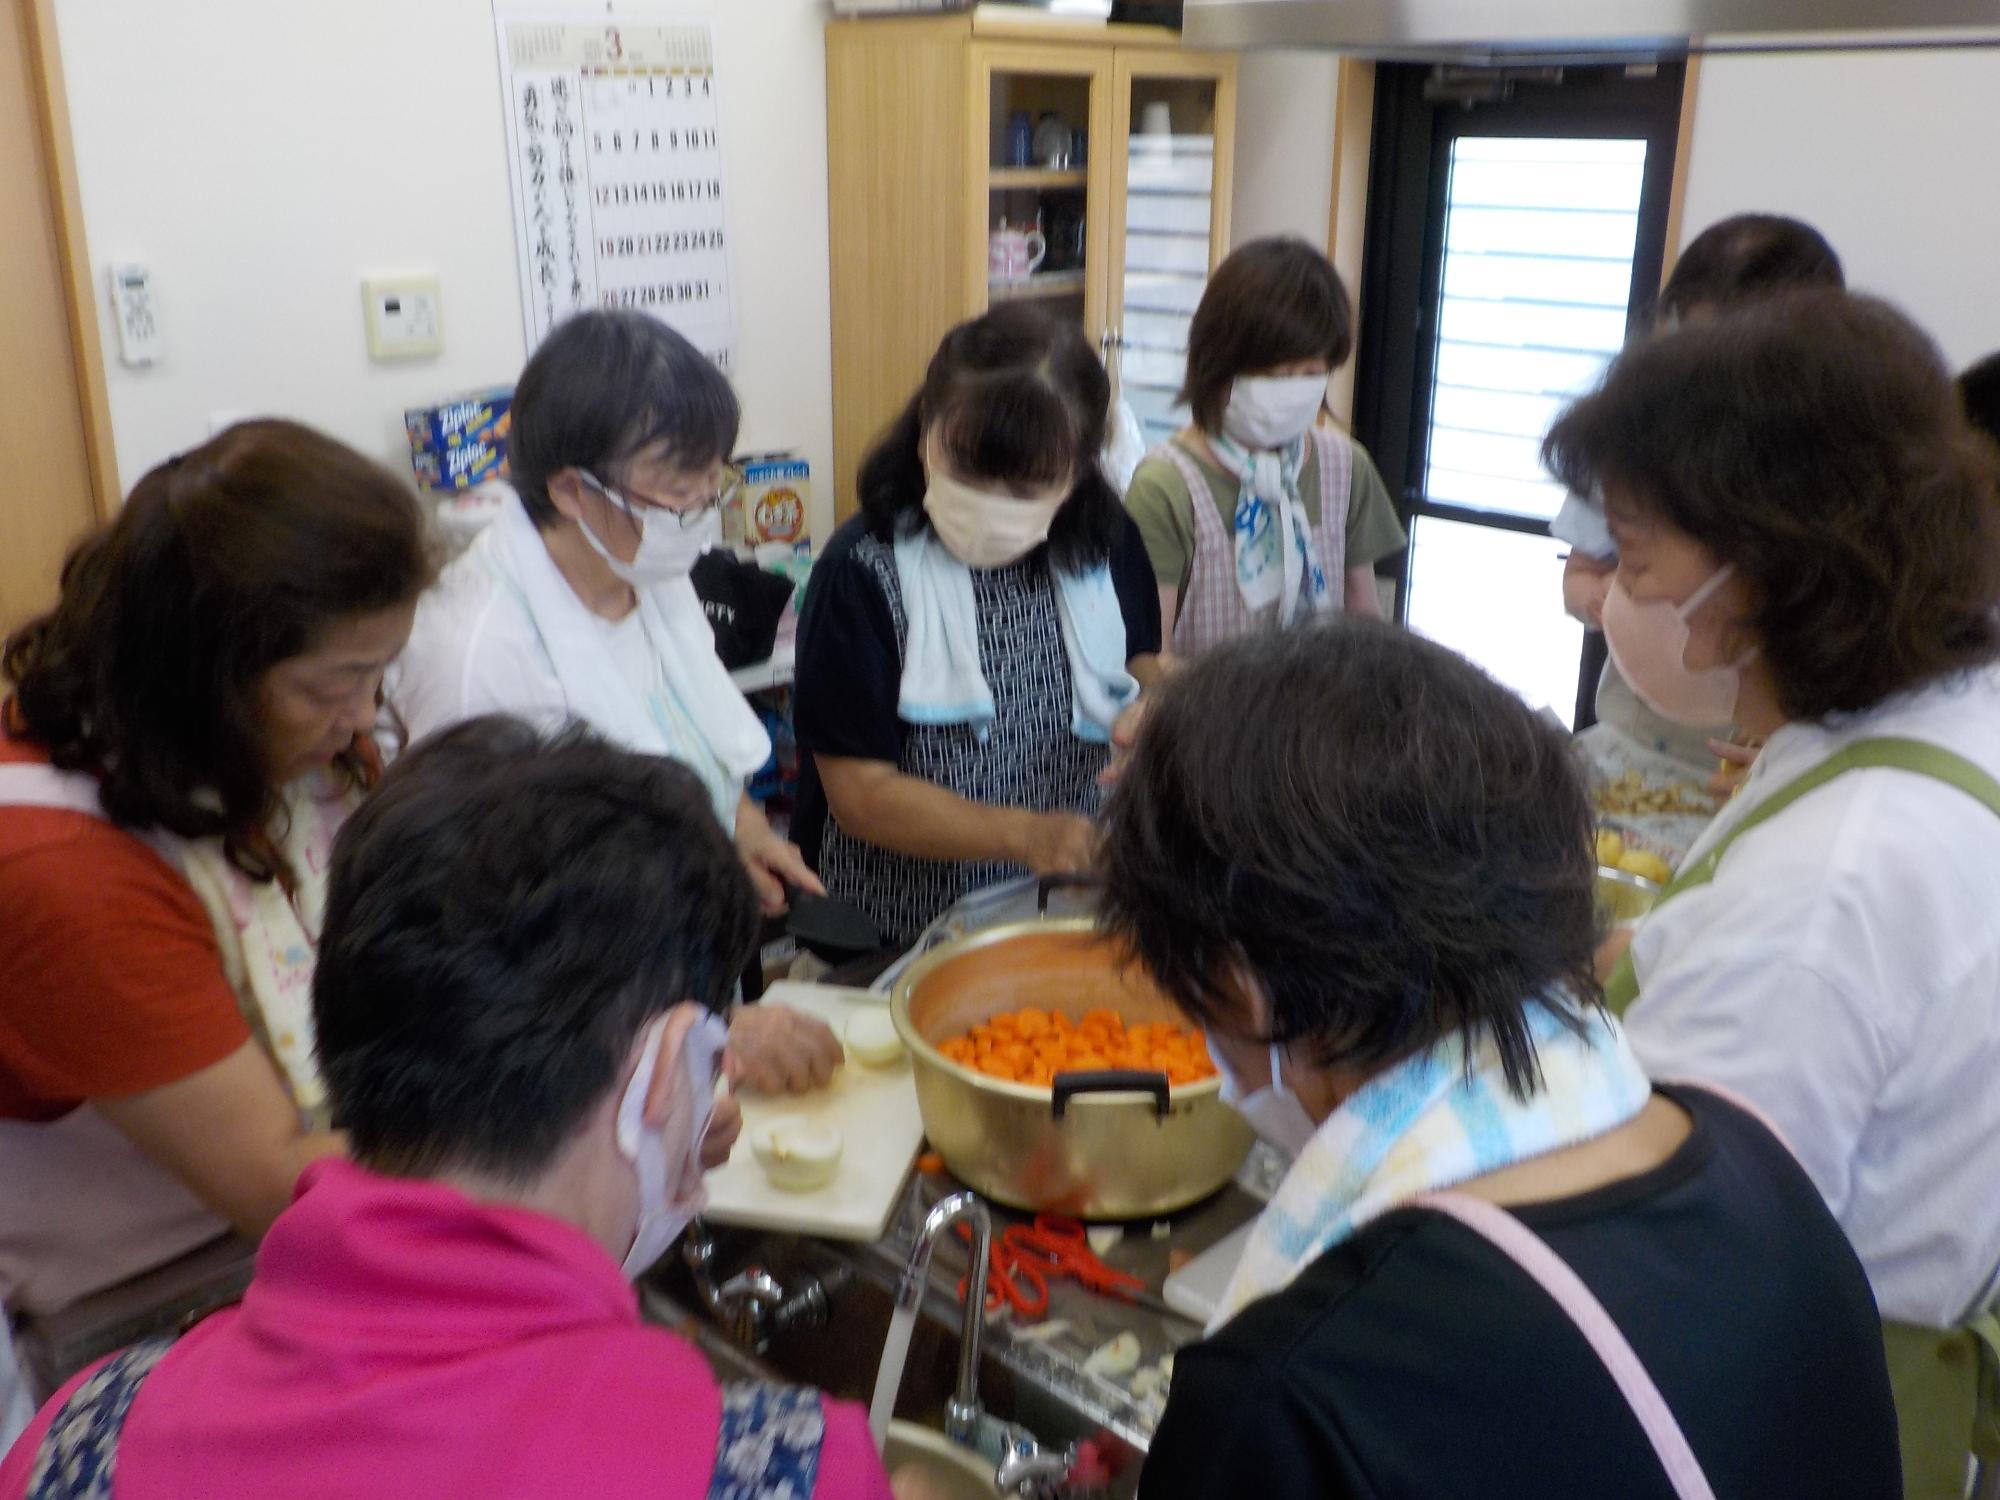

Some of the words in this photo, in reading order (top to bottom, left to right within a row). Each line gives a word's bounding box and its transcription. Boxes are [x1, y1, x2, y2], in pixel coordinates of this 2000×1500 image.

[685, 128, 699, 149] 10
[703, 127, 717, 148] 11
[596, 186, 609, 206] 12
[614, 185, 629, 206] 13
[634, 184, 648, 206] 14
[653, 183, 667, 205] 15
[671, 182, 685, 204] 16
[689, 181, 702, 204] 17
[707, 180, 721, 202] 18
[618, 235, 634, 257] 20
[638, 234, 652, 257] 21
[656, 232, 671, 255] 22
[674, 231, 689, 253] 23
[692, 230, 706, 252] 24
[709, 228, 724, 250] 25
[677, 281, 693, 303] 30
[696, 279, 710, 300] 31
[439, 400, 483, 436] Ziploc
[447, 441, 488, 477] Ziploc
